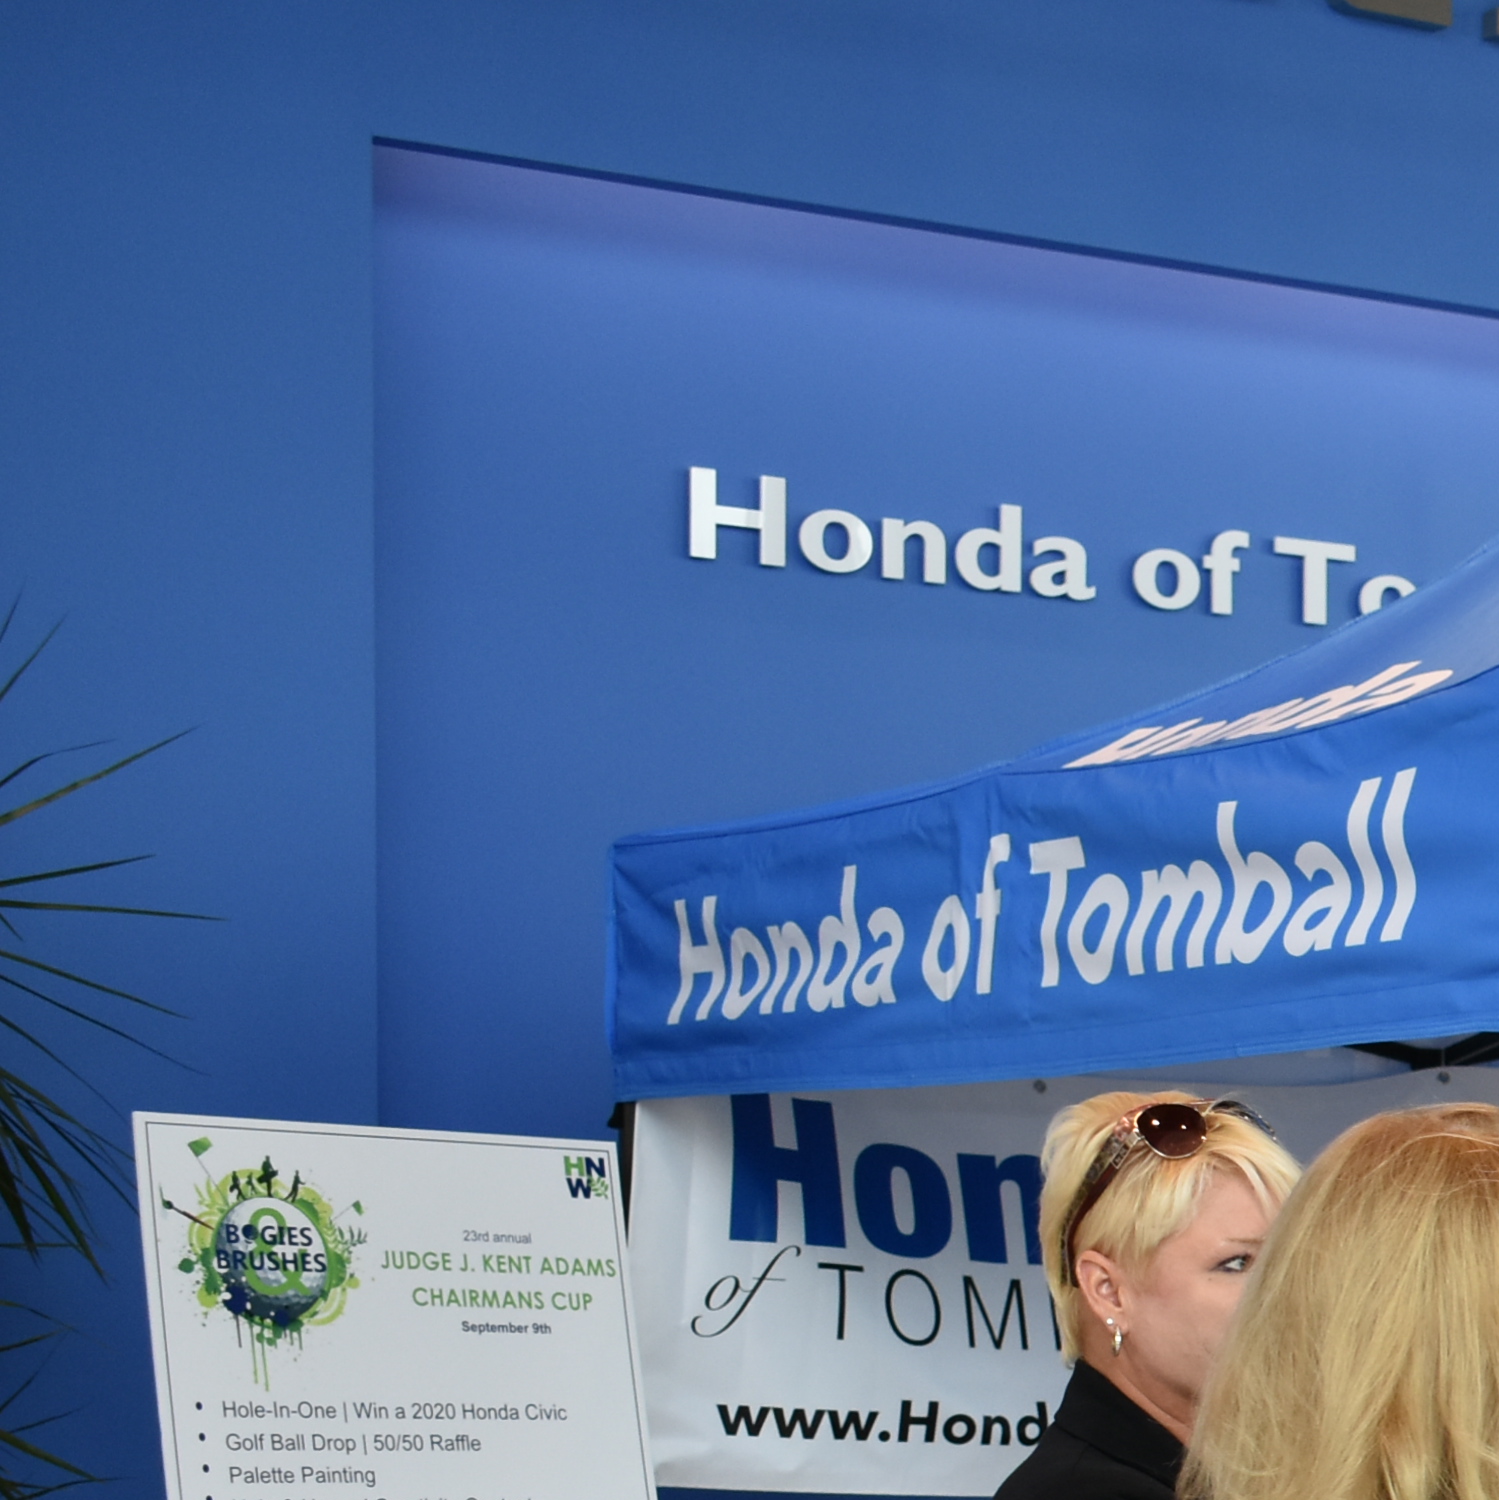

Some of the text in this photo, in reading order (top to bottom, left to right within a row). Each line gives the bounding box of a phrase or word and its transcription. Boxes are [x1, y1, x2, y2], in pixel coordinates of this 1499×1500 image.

[690, 466, 1096, 604] Honda
[1133, 529, 1250, 618] of
[666, 767, 1418, 1026] Honda of Tomball
[729, 1093, 1042, 1265] Hon
[462, 1230, 532, 1244] 23rd annual
[216, 1249, 327, 1273] BRUSHES
[381, 1250, 617, 1277] JUDGE J. KENT ADAMS
[412, 1287, 593, 1311] CHAIRMANS CUP
[690, 1245, 801, 1338] of
[461, 1321, 552, 1335] September 9th
[222, 1400, 337, 1419] Hole-In-One
[352, 1401, 389, 1419] Win
[395, 1406, 406, 1420] a
[411, 1402, 456, 1420] 2020
[461, 1403, 520, 1420] Honda
[525, 1403, 568, 1421] Civic
[225, 1433, 265, 1451] Golf
[270, 1433, 306, 1451] Ball
[311, 1433, 357, 1455] Drop
[373, 1434, 424, 1451] 50/50
[429, 1434, 482, 1451] Raffle
[228, 1466, 376, 1487] Palette Painting
